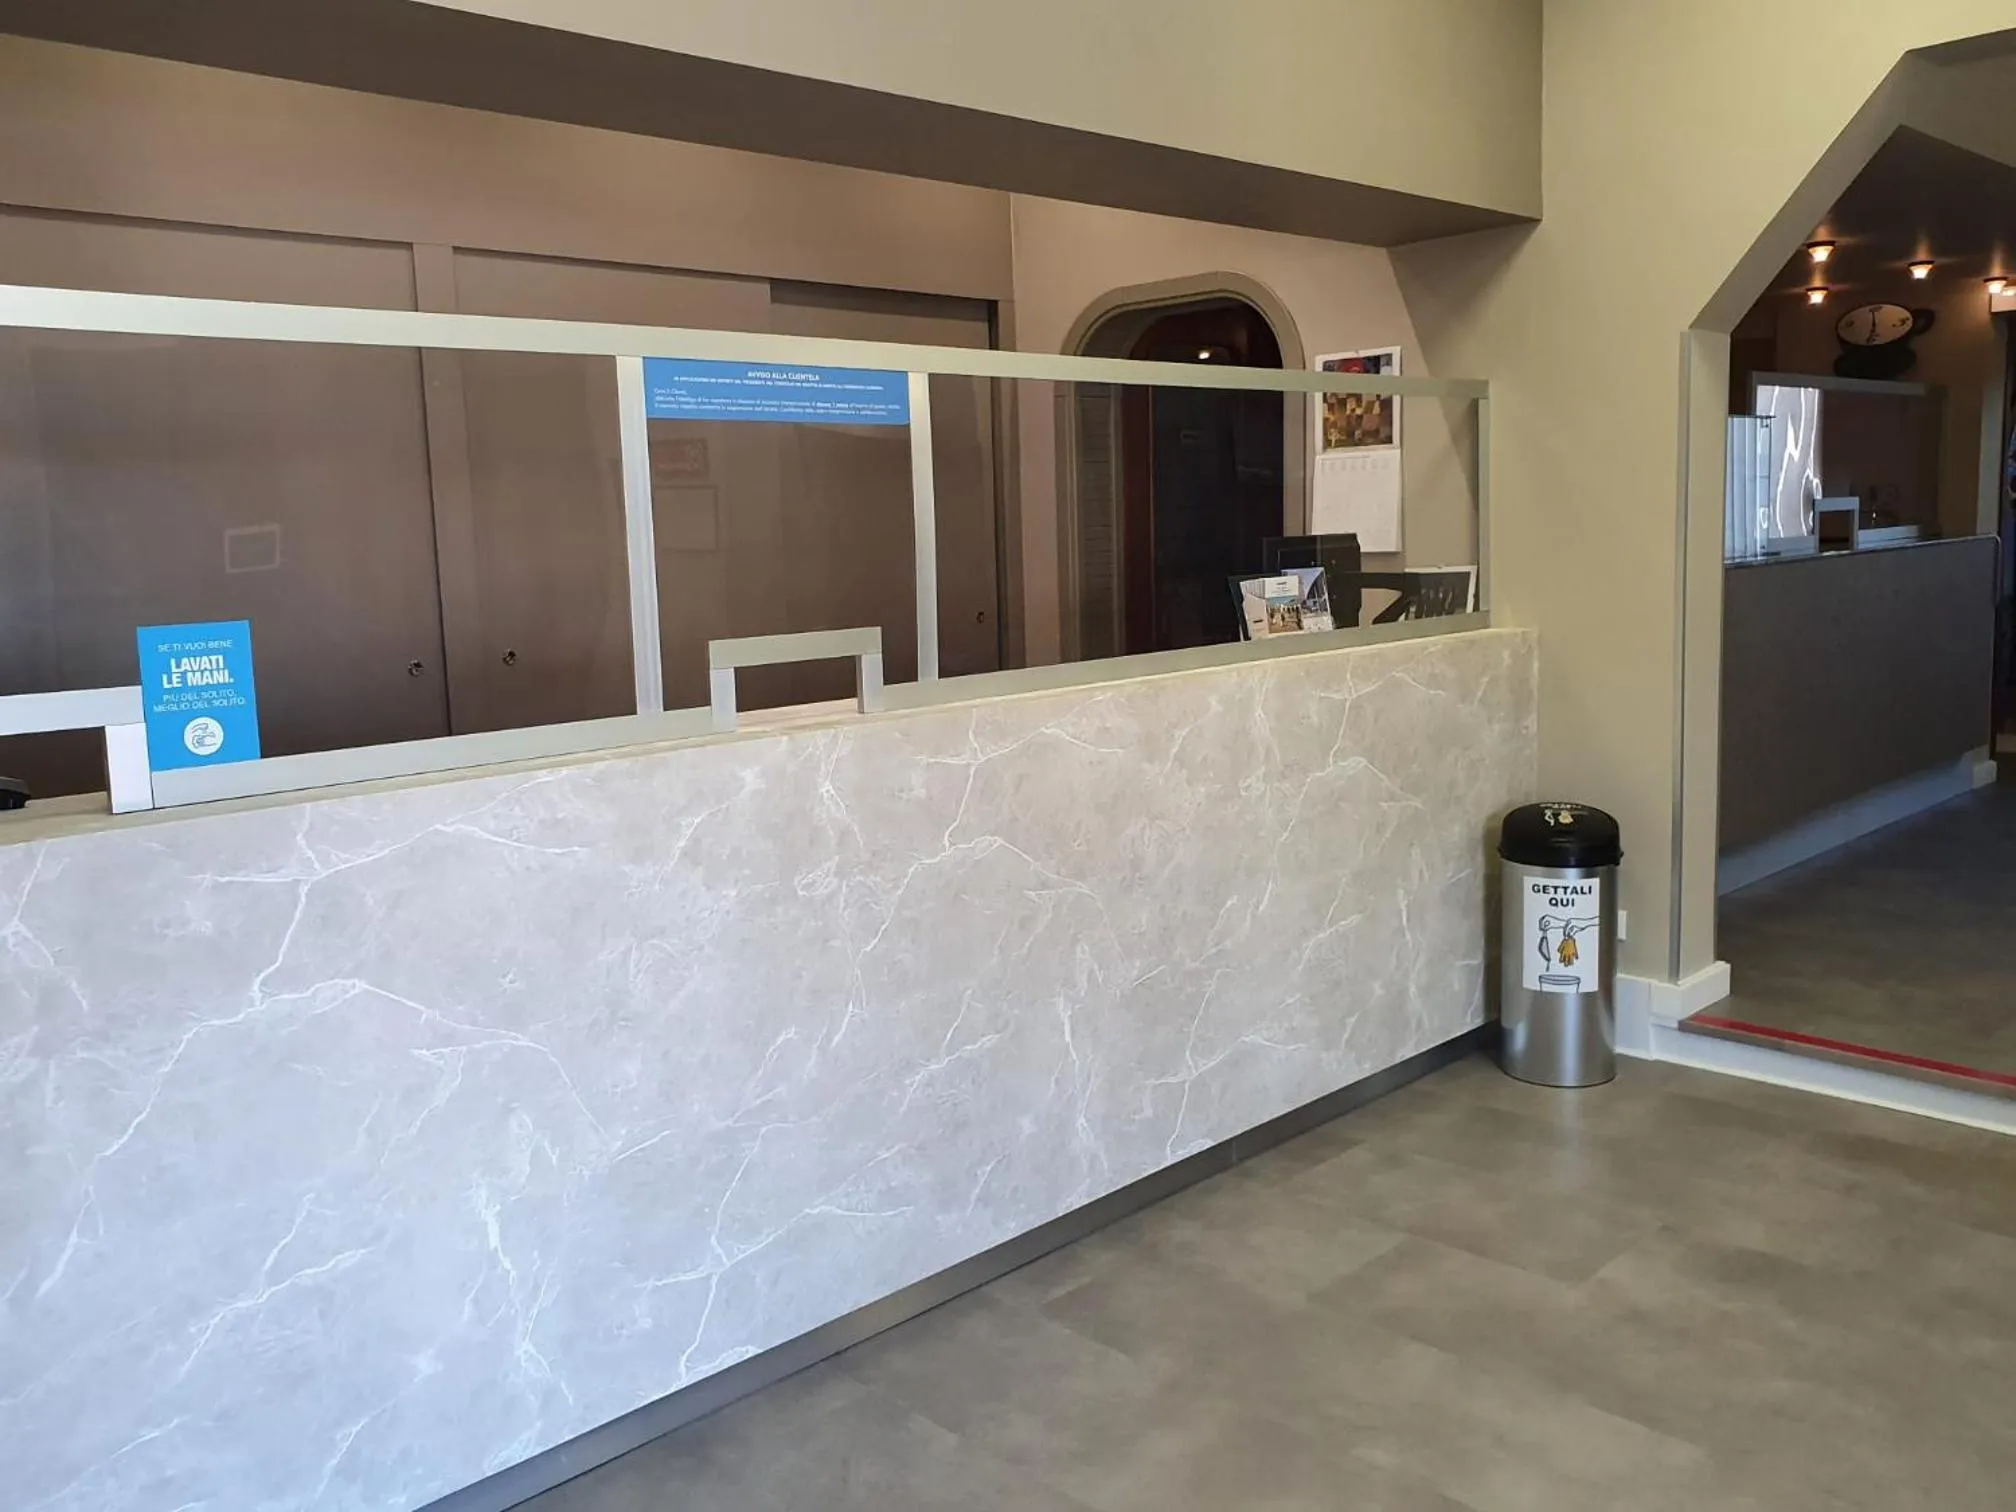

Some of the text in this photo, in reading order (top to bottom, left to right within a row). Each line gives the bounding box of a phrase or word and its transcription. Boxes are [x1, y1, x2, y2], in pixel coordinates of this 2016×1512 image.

[748, 371, 771, 379] AVVISO
[788, 373, 820, 381] CLIENTELA
[157, 639, 233, 653] SE TI VUOI BENE
[170, 654, 224, 673] LAVATI
[162, 669, 234, 689] LE MANI.
[180, 691, 200, 701] DEL
[153, 701, 190, 712] MEGLIO
[191, 700, 209, 710] DEL
[1531, 883, 1592, 896] GETTALI
[1548, 897, 1575, 908] QUI
